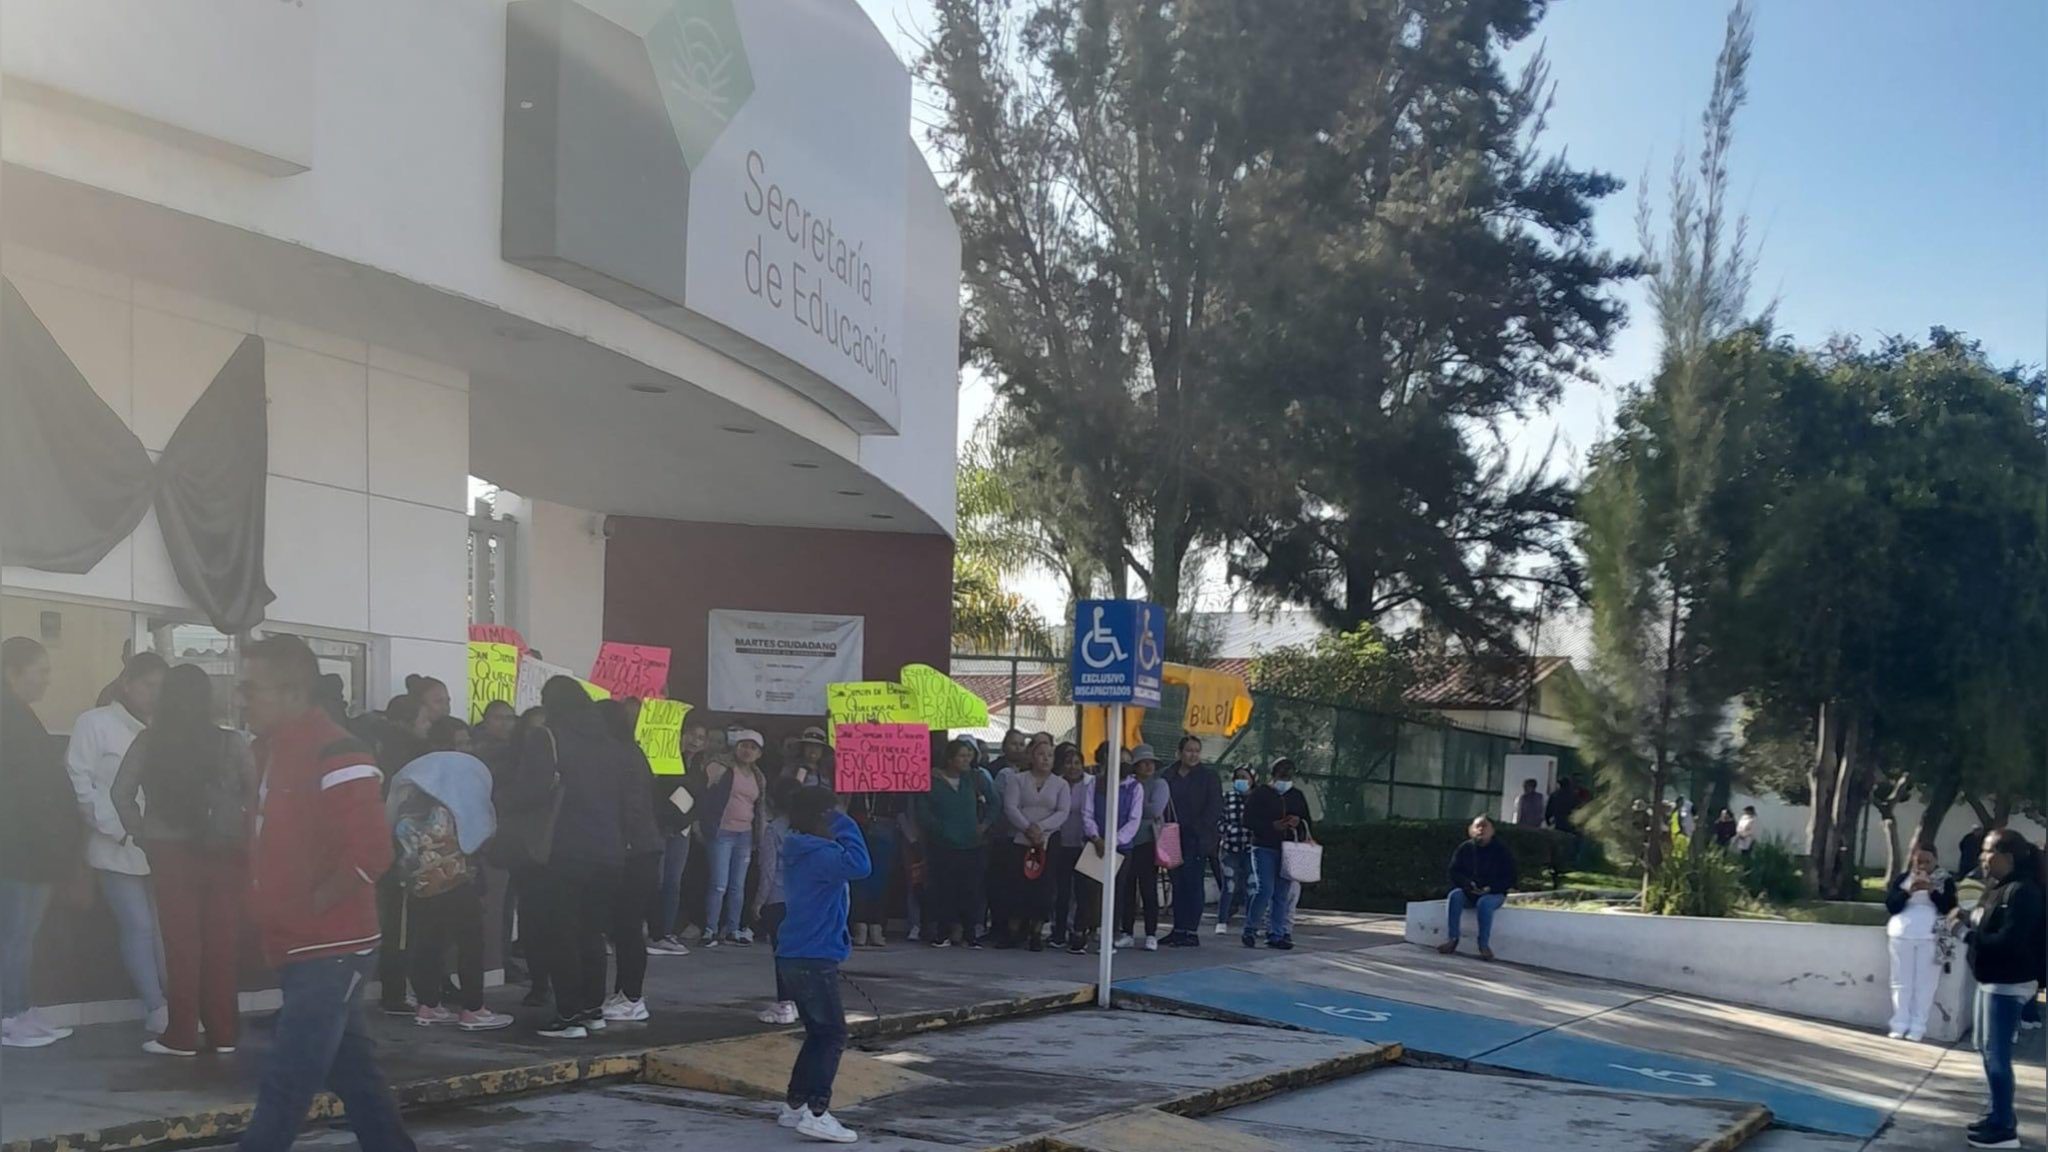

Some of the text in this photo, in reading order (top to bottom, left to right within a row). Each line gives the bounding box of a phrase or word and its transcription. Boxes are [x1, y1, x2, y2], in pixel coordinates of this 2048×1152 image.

[744, 149, 872, 305] Secretaría
[744, 235, 898, 395] de Educación
[735, 638, 837, 651] MARTES CIUDADANO
[1081, 673, 1125, 684] EXCLUSIVO
[1074, 685, 1131, 697] DISCAPACITADOS
[922, 694, 975, 718] BRAVO
[841, 770, 929, 791] MAESTROS
